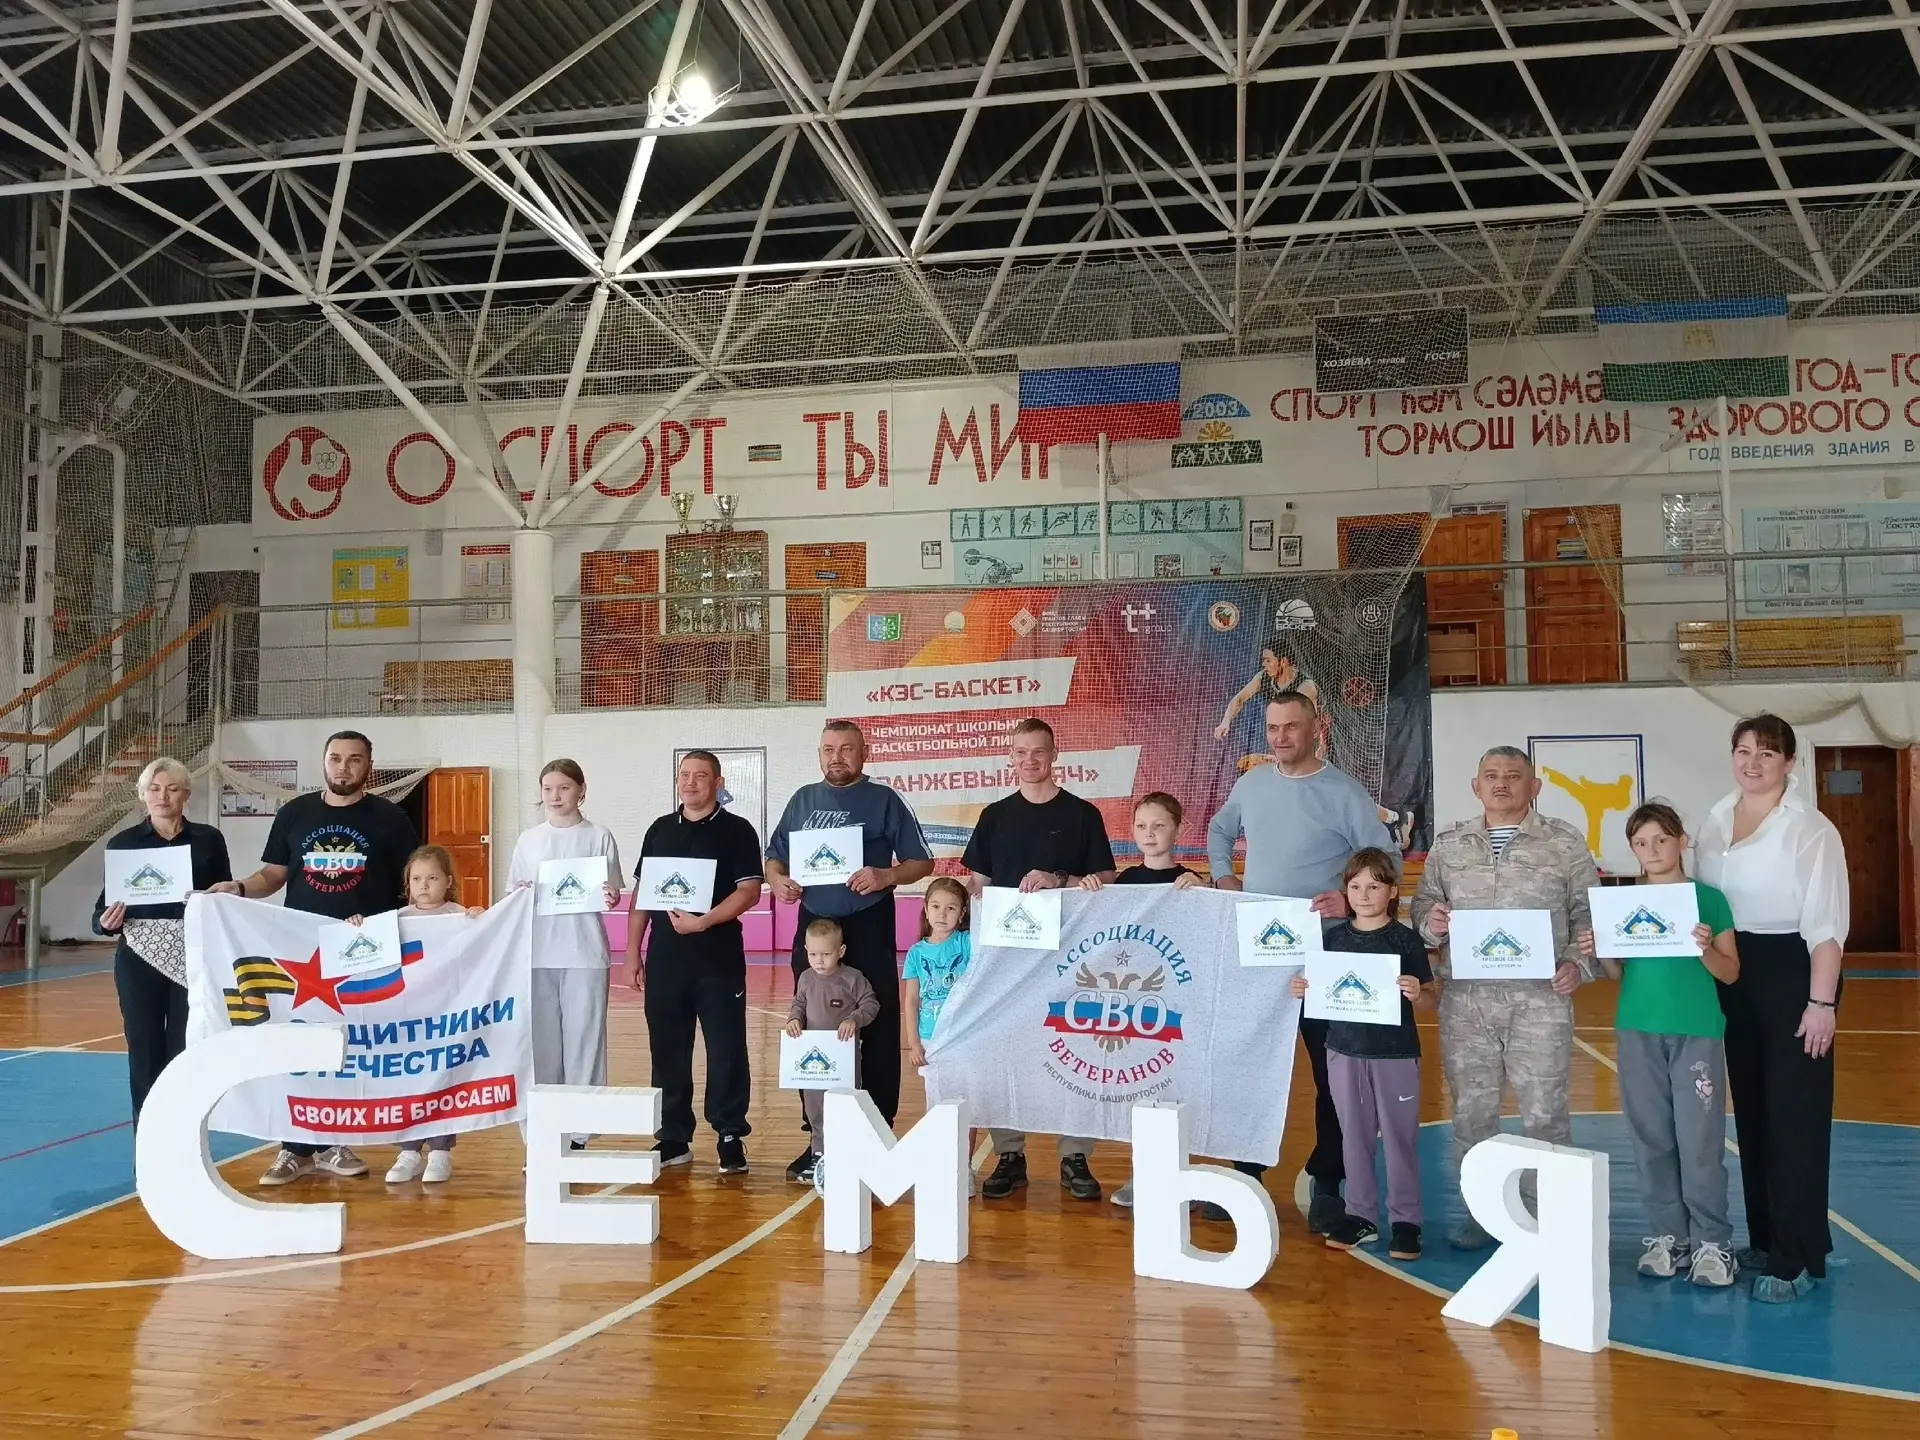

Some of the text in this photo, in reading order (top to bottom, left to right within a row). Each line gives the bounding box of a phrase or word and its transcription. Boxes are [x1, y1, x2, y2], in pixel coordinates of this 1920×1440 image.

[1322, 357, 1371, 368] ХОЗЯЕВА
[1424, 351, 1461, 361] ГОСТИ
[1193, 401, 1239, 417] 2003
[1667, 397, 1891, 443] ЗДОРОВОГО
[1357, 408, 1631, 458] ТОРМОШ ЙЫЛЫ
[802, 410, 889, 491] ТЫ
[1689, 447, 1721, 461] ГОД
[1731, 443, 1814, 460] ВВЕДЕНИЯ
[1828, 440, 1890, 456] ЗДАНИЯ
[1145, 625, 1172, 634] group
[866, 675, 1042, 703] «КЭС-БАСКЕТ»
[871, 716, 1032, 738] ЧЕМПИОНАТ ШКОЛЬН
[872, 734, 987, 754] БАСКЕТБОЛЬНОЙ
[1051, 764, 1100, 783] ЯЧ»
[802, 810, 850, 830] NIKE
[301, 825, 370, 849] АССОЦИАЦИЯ
[310, 854, 358, 872] СВО
[305, 874, 362, 892] ВЕТЕРАНОВ
[1055, 924, 1193, 986] АССОЦИАЦИЯ
[290, 997, 514, 1050] ЩИТНИКИ
[1064, 990, 1167, 1036] СВО
[1049, 1037, 1175, 1085] ВЕТЕРАНОВ
[1042, 1061, 1173, 1103] РЕСПУБЛИКА БАШКОРТОСТАН
[293, 1083, 512, 1126] СВОИХ НЕ БРОСАЕМ
